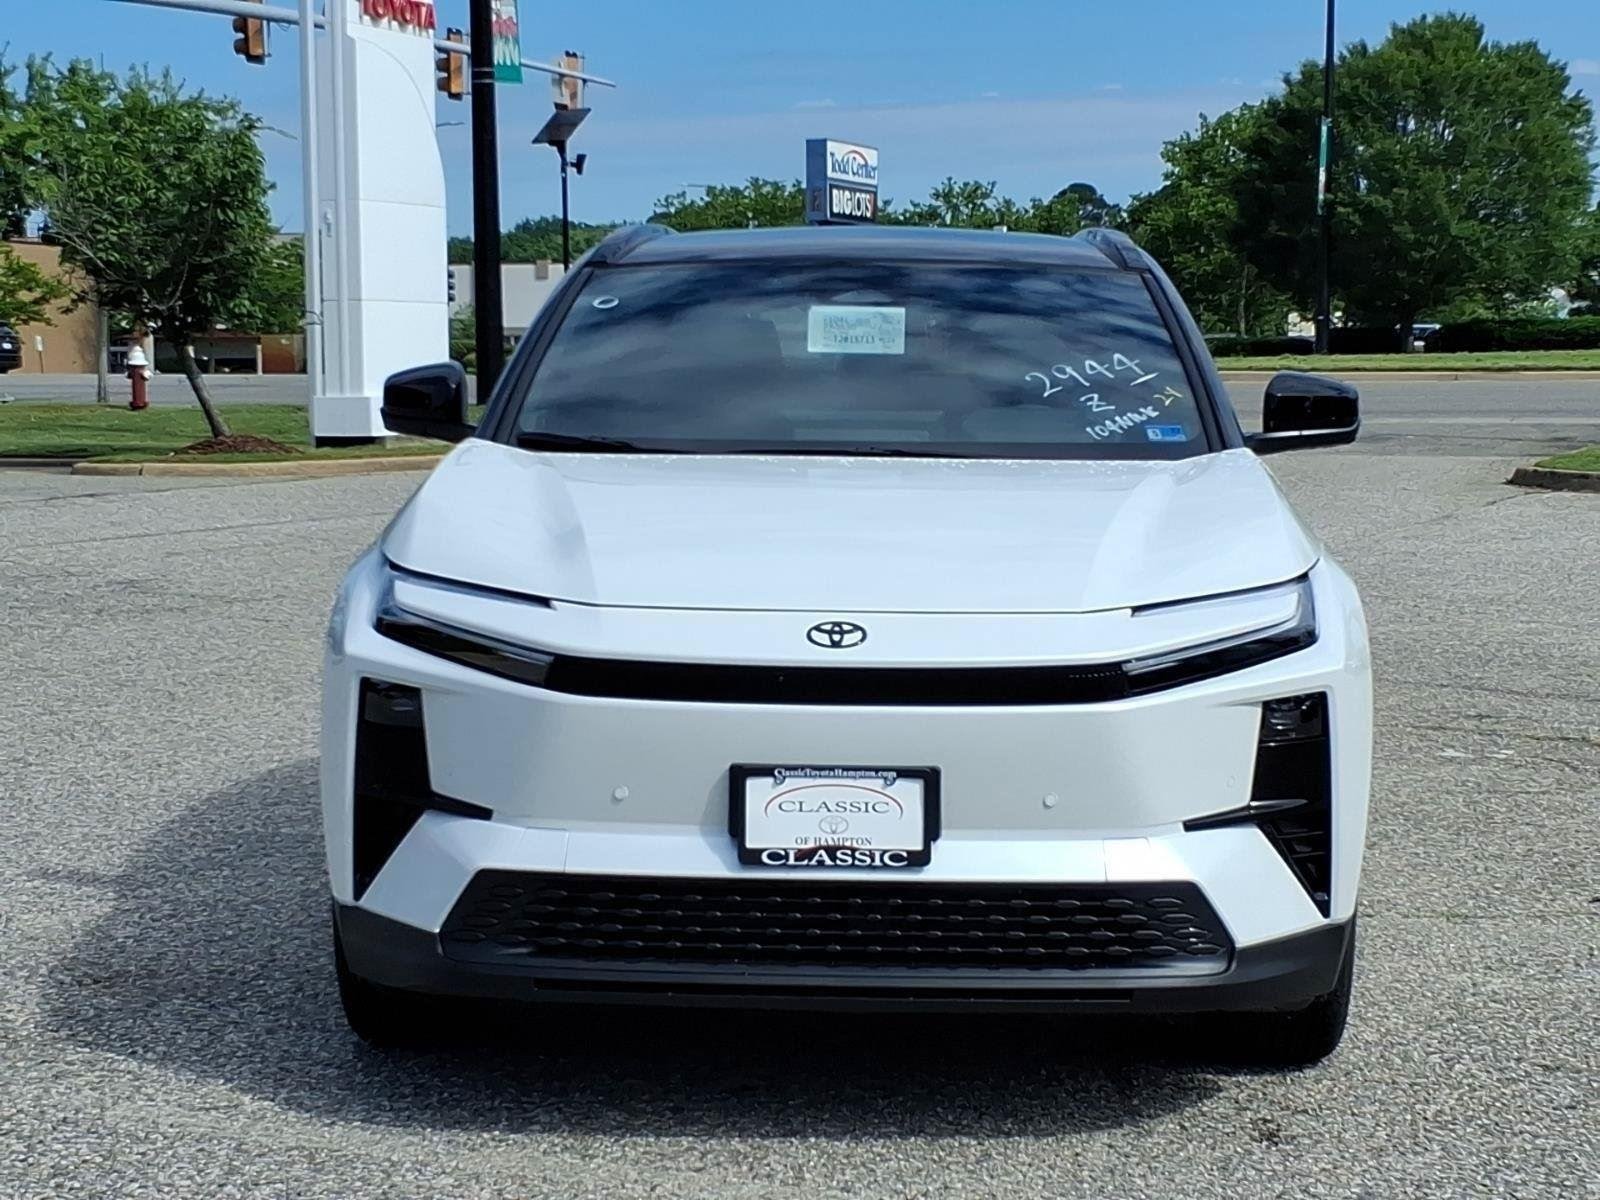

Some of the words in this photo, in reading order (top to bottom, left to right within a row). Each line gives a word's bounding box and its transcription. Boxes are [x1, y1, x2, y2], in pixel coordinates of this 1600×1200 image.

[357, 0, 436, 30] TOYOTA
[778, 800, 889, 814] CLASSIC
[795, 836, 809, 846] OF
[814, 837, 872, 846] HAMPTON
[761, 850, 908, 866] CLASSIC
